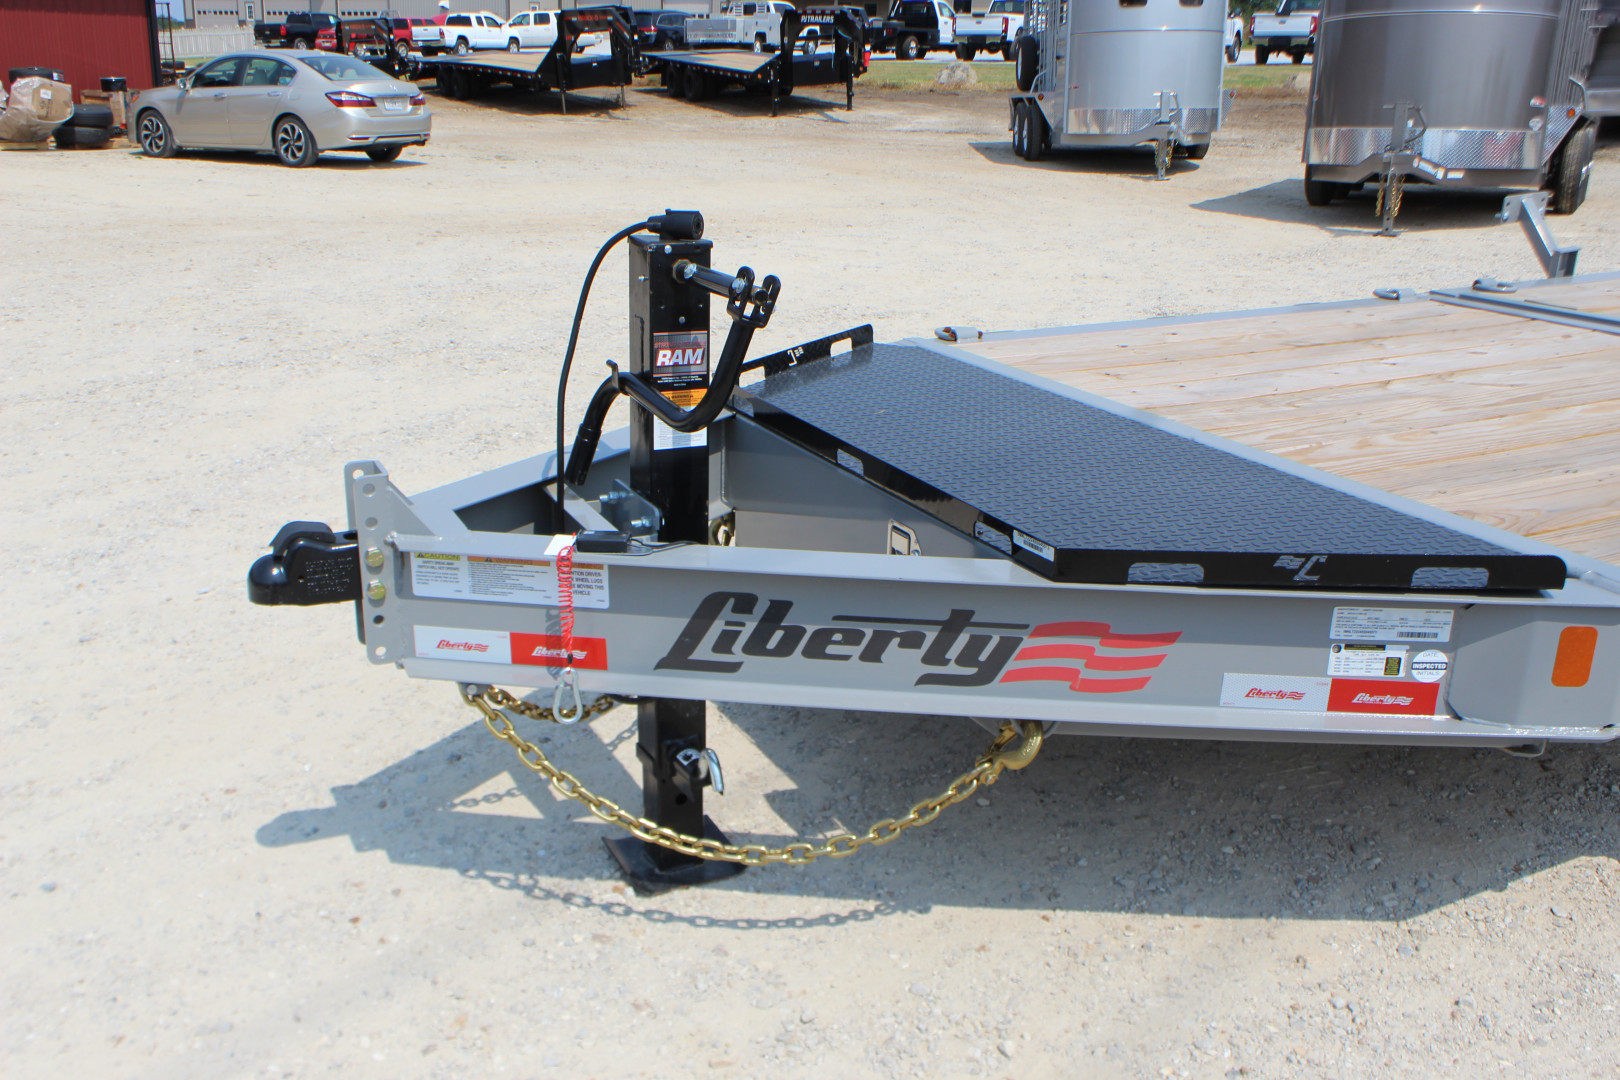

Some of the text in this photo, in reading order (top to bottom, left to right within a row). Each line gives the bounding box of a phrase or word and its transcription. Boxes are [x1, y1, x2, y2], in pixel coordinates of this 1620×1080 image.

[656, 348, 704, 367] RAM
[436, 639, 473, 651] Liberty
[654, 591, 1029, 687] Liberty
[1244, 687, 1288, 699] Liberty
[1351, 692, 1397, 705] Liberty
